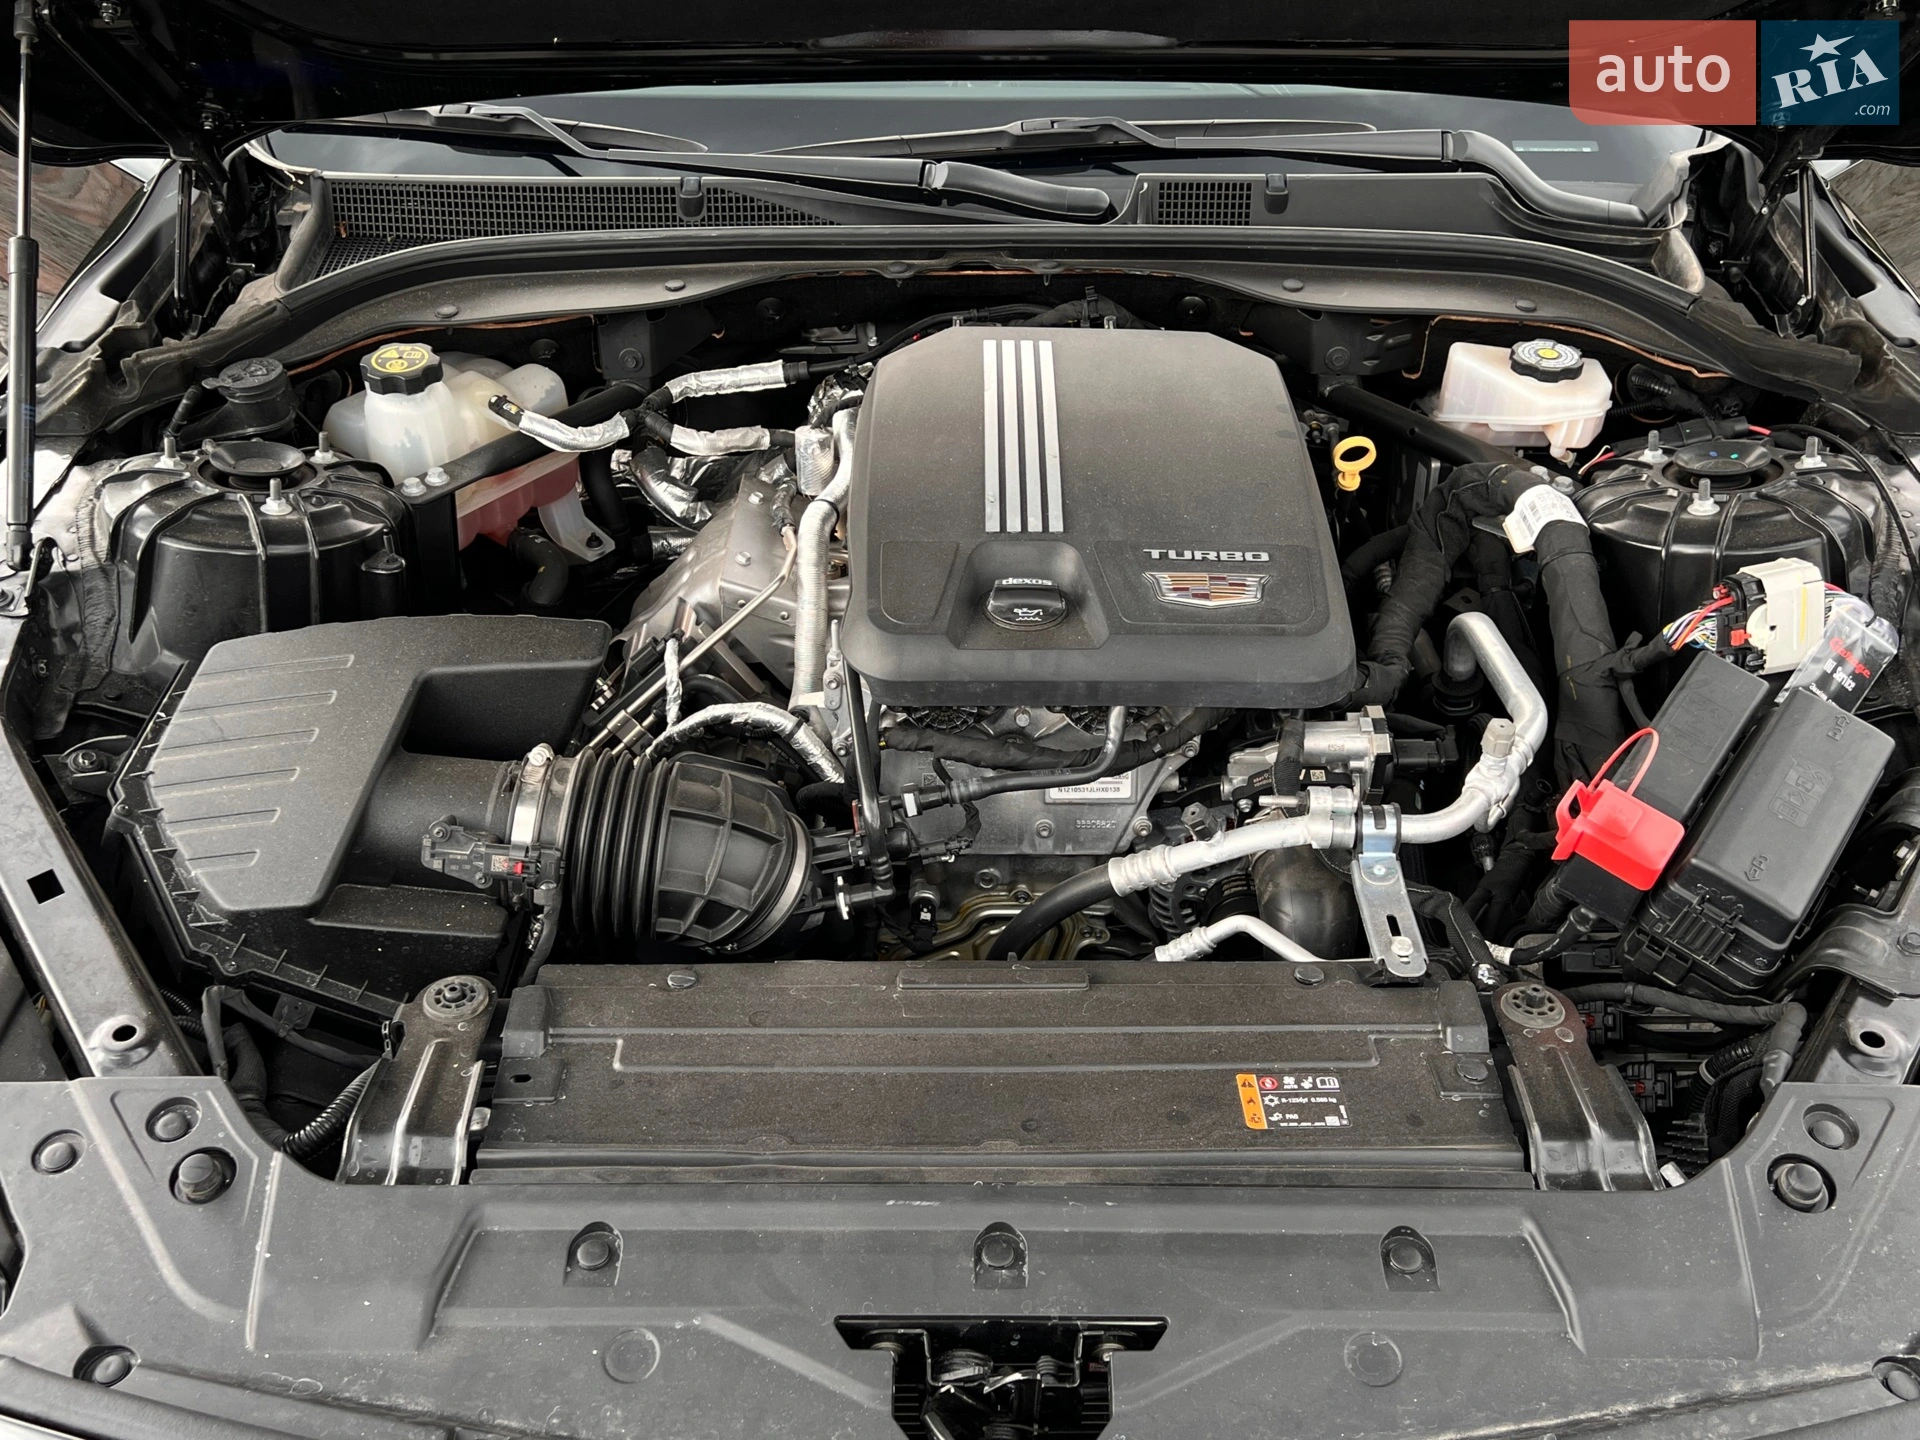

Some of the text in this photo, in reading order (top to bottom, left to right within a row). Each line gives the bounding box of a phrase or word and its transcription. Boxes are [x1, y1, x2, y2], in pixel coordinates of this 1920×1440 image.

[1143, 548, 1271, 562] TURBO
[1002, 576, 1053, 586] dexos
[1829, 637, 1871, 679] Garage
[1832, 666, 1857, 692] Service
